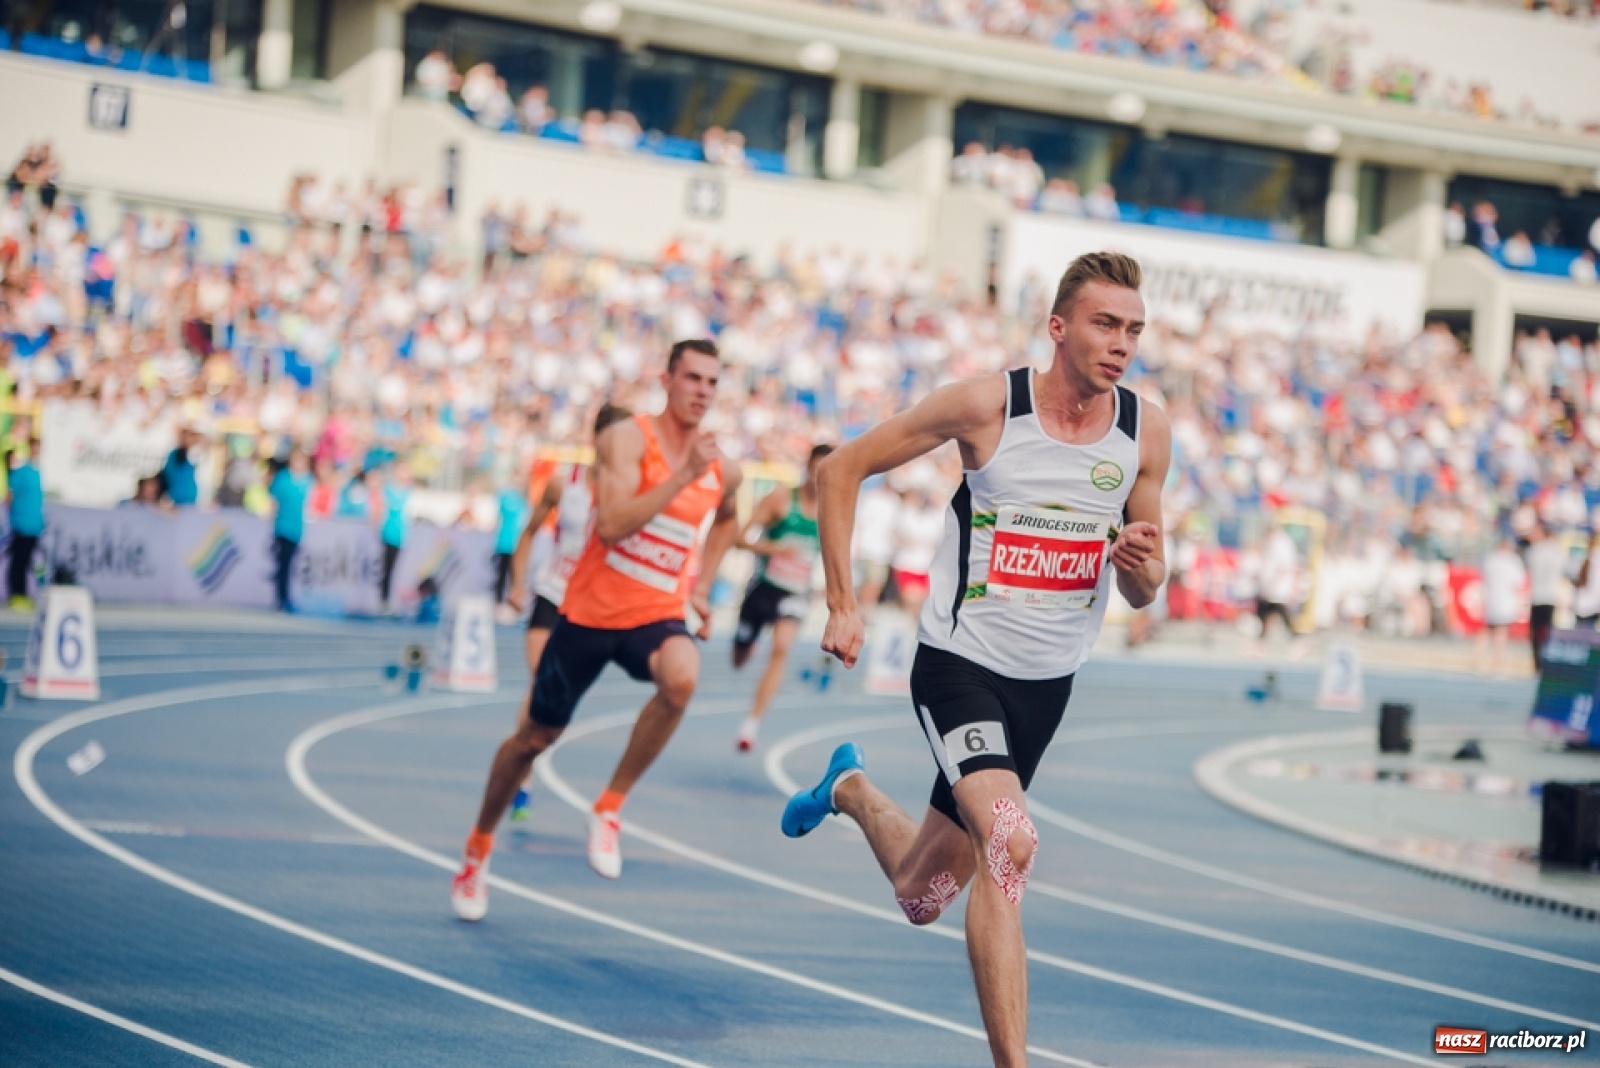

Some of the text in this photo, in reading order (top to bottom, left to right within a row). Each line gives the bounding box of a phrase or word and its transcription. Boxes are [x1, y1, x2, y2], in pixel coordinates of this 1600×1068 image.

[1011, 512, 1100, 534] BRIDGESTONE
[993, 542, 1099, 581] RZEŹNICZAK
[58, 614, 82, 669] 6
